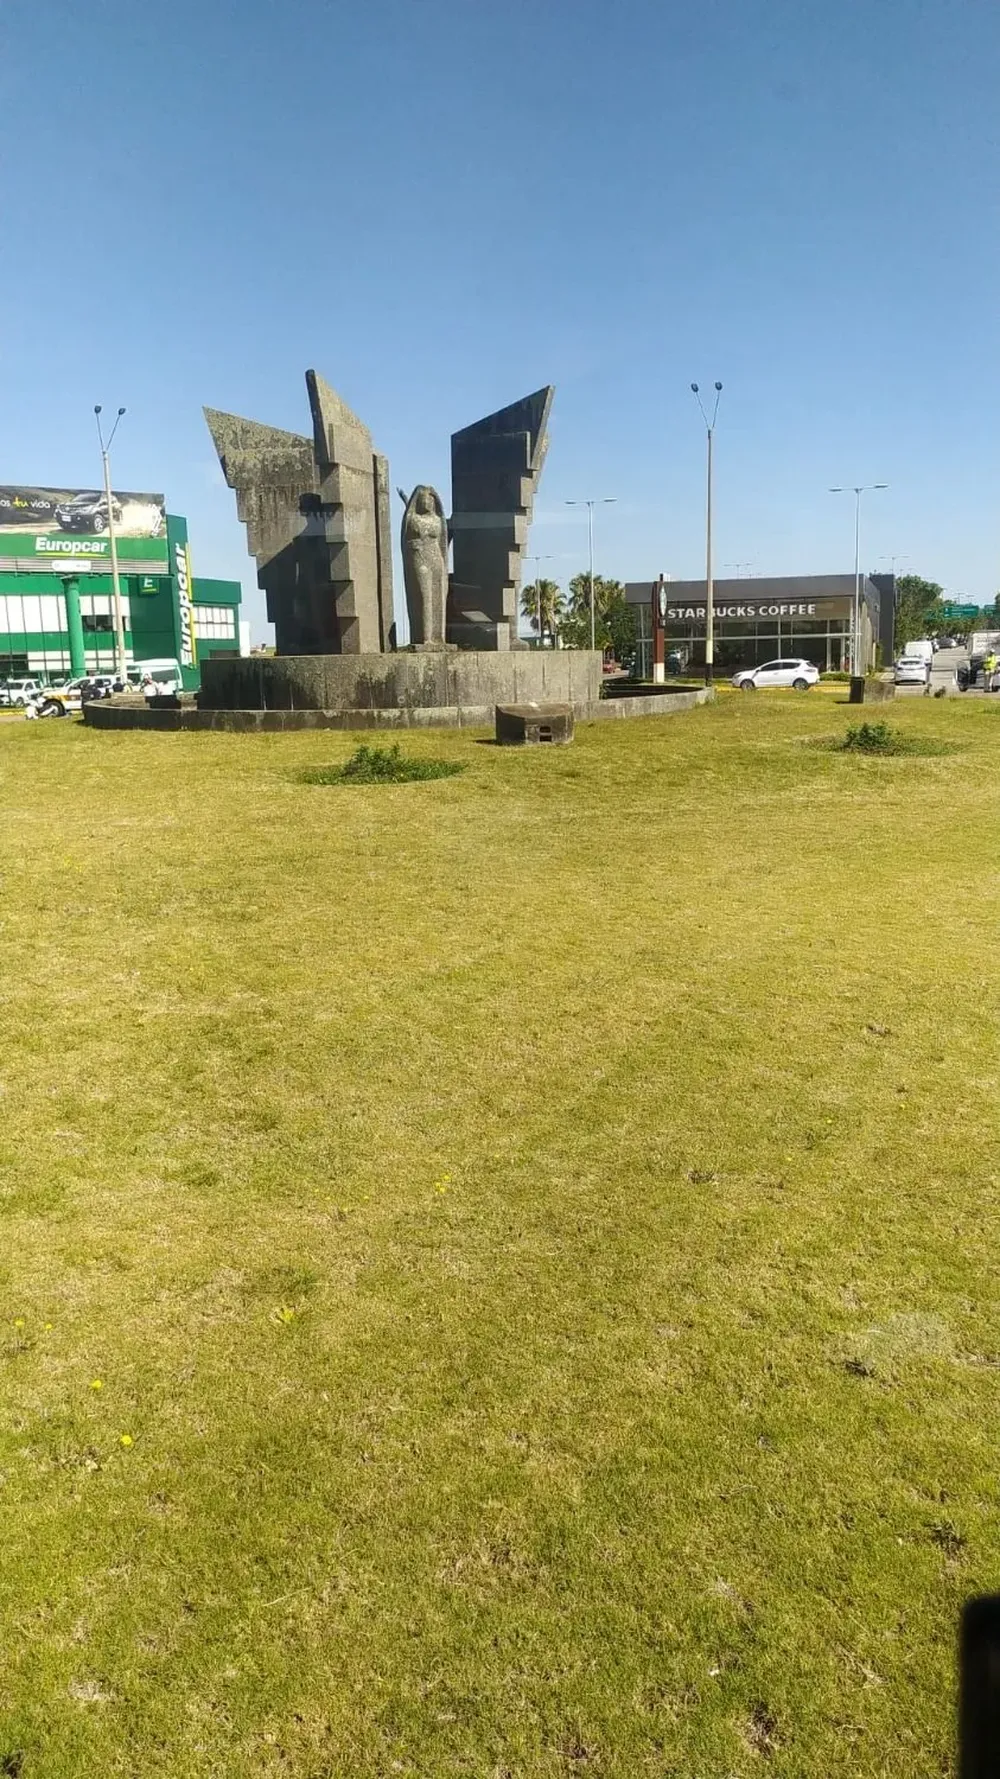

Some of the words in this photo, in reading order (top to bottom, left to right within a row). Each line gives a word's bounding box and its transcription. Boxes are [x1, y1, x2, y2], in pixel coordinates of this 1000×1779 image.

[35, 536, 108, 557] Europcar
[175, 542, 194, 665] Europcar
[758, 603, 817, 616] COFFEE
